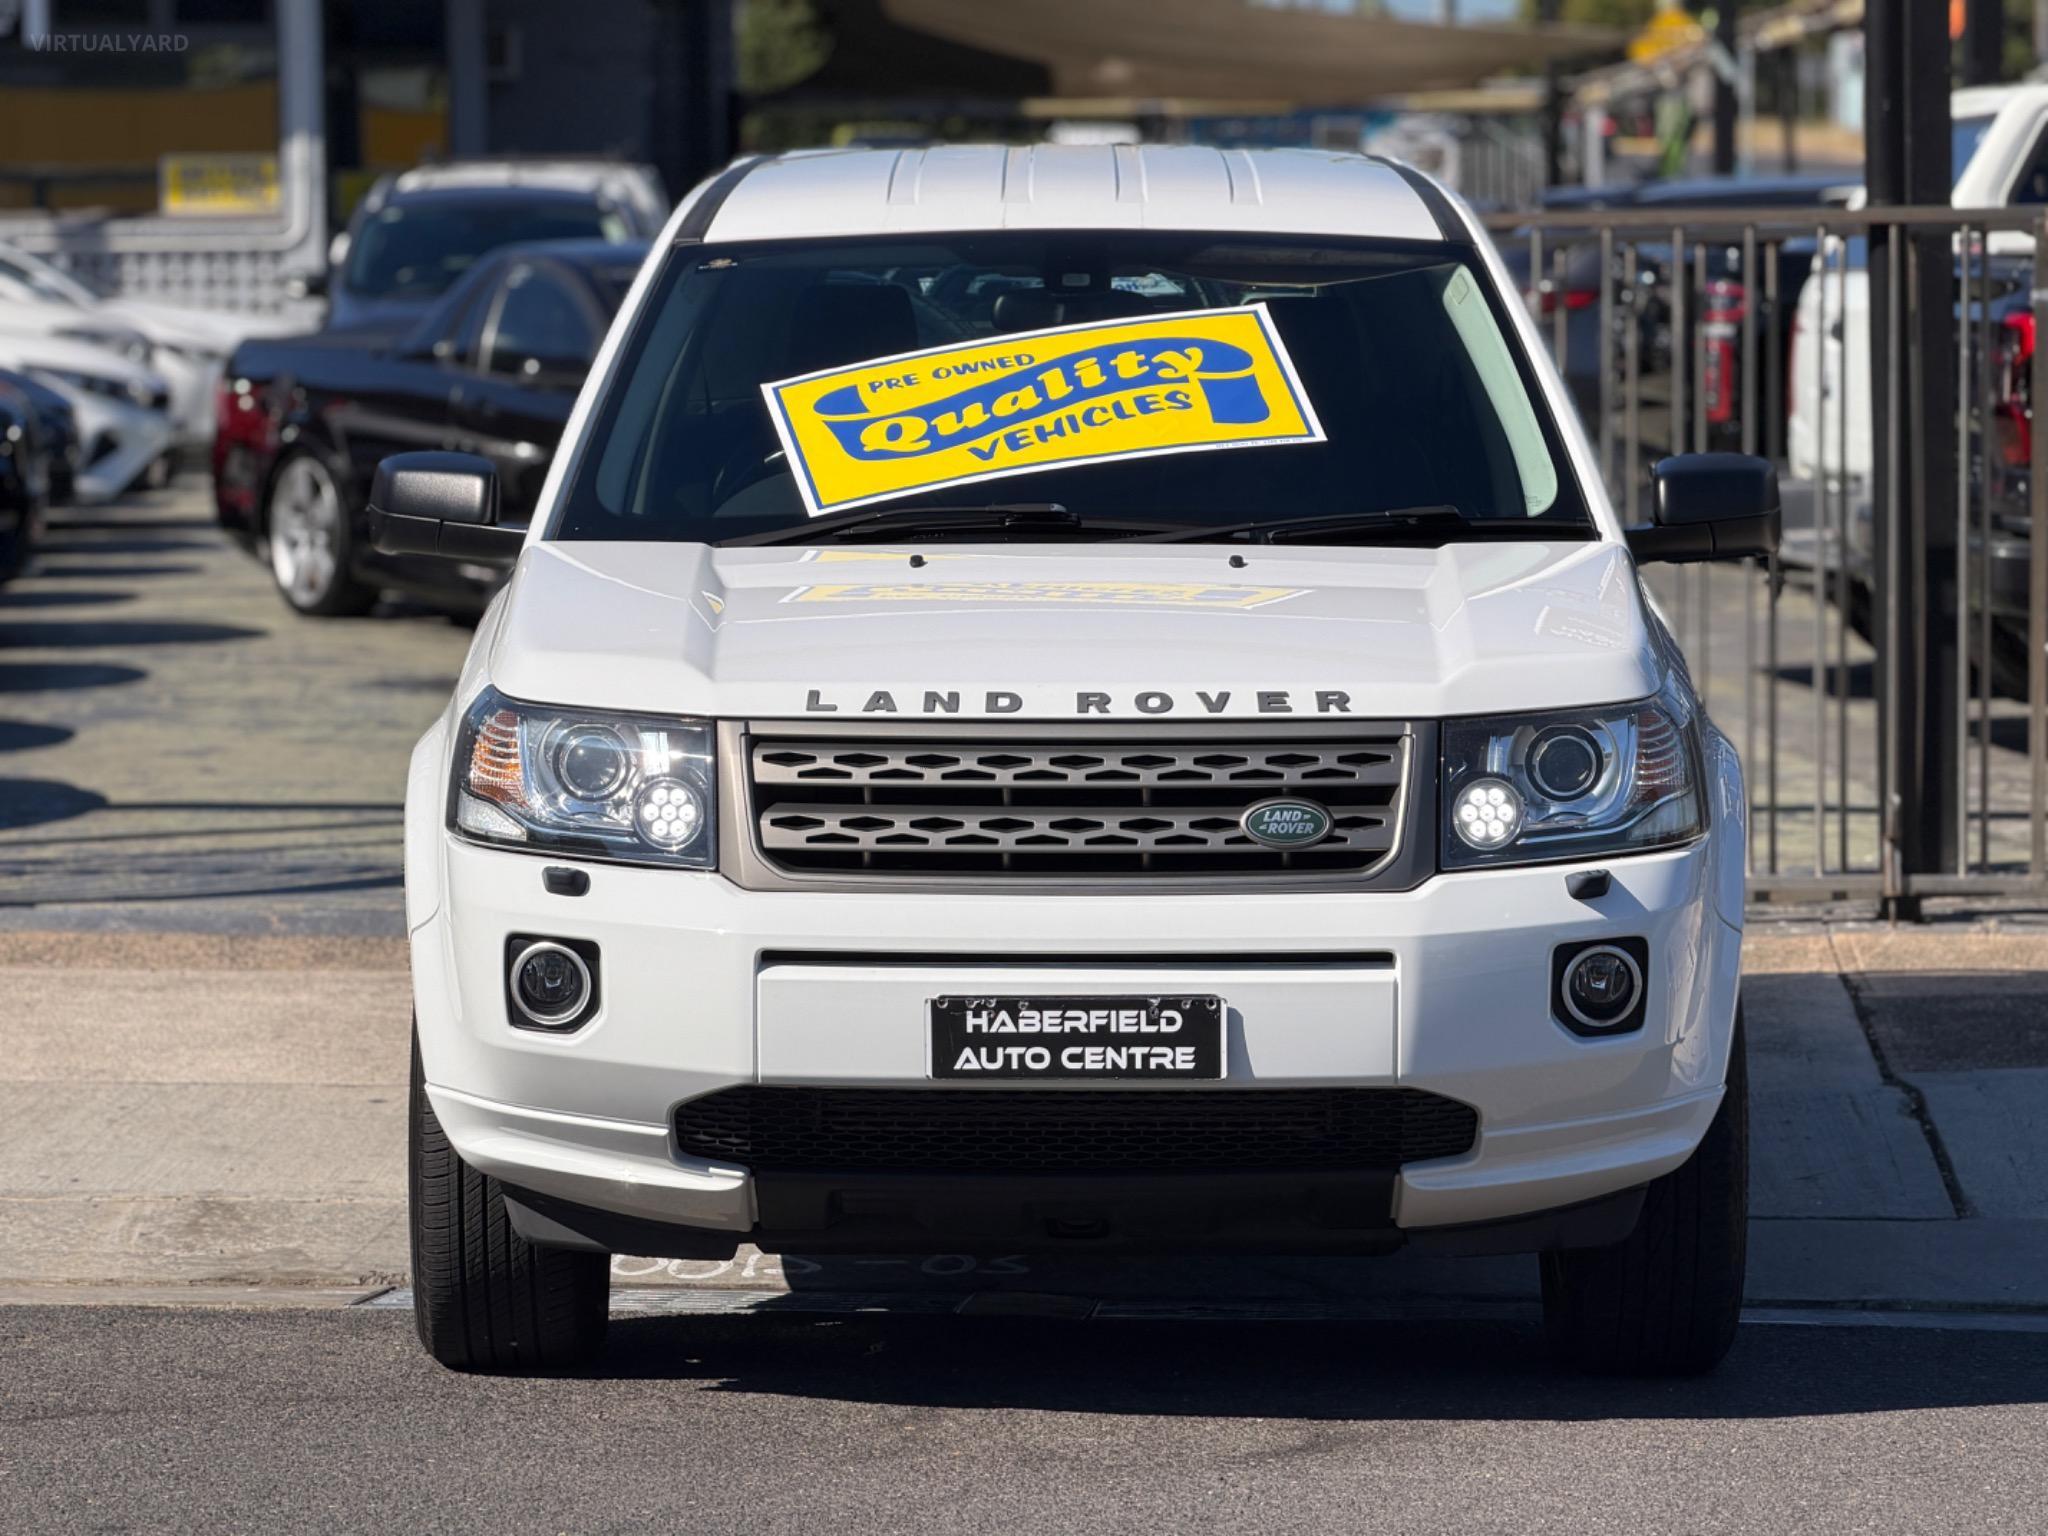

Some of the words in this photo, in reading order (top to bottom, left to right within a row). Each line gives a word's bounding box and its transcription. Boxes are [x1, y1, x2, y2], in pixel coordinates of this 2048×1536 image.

[868, 373, 921, 394] PRE
[932, 353, 1035, 380] OWNED
[860, 347, 1204, 452] Quality
[967, 390, 1194, 462] VEHICLES
[806, 689, 1023, 714] LAND
[1076, 691, 1352, 714] ROVER
[1263, 810, 1302, 822] LAND
[1267, 822, 1314, 834] ROVER
[965, 1010, 1183, 1033] HABERFIELD
[953, 1047, 1051, 1070] AUTO
[1061, 1047, 1196, 1070] CENTRE
